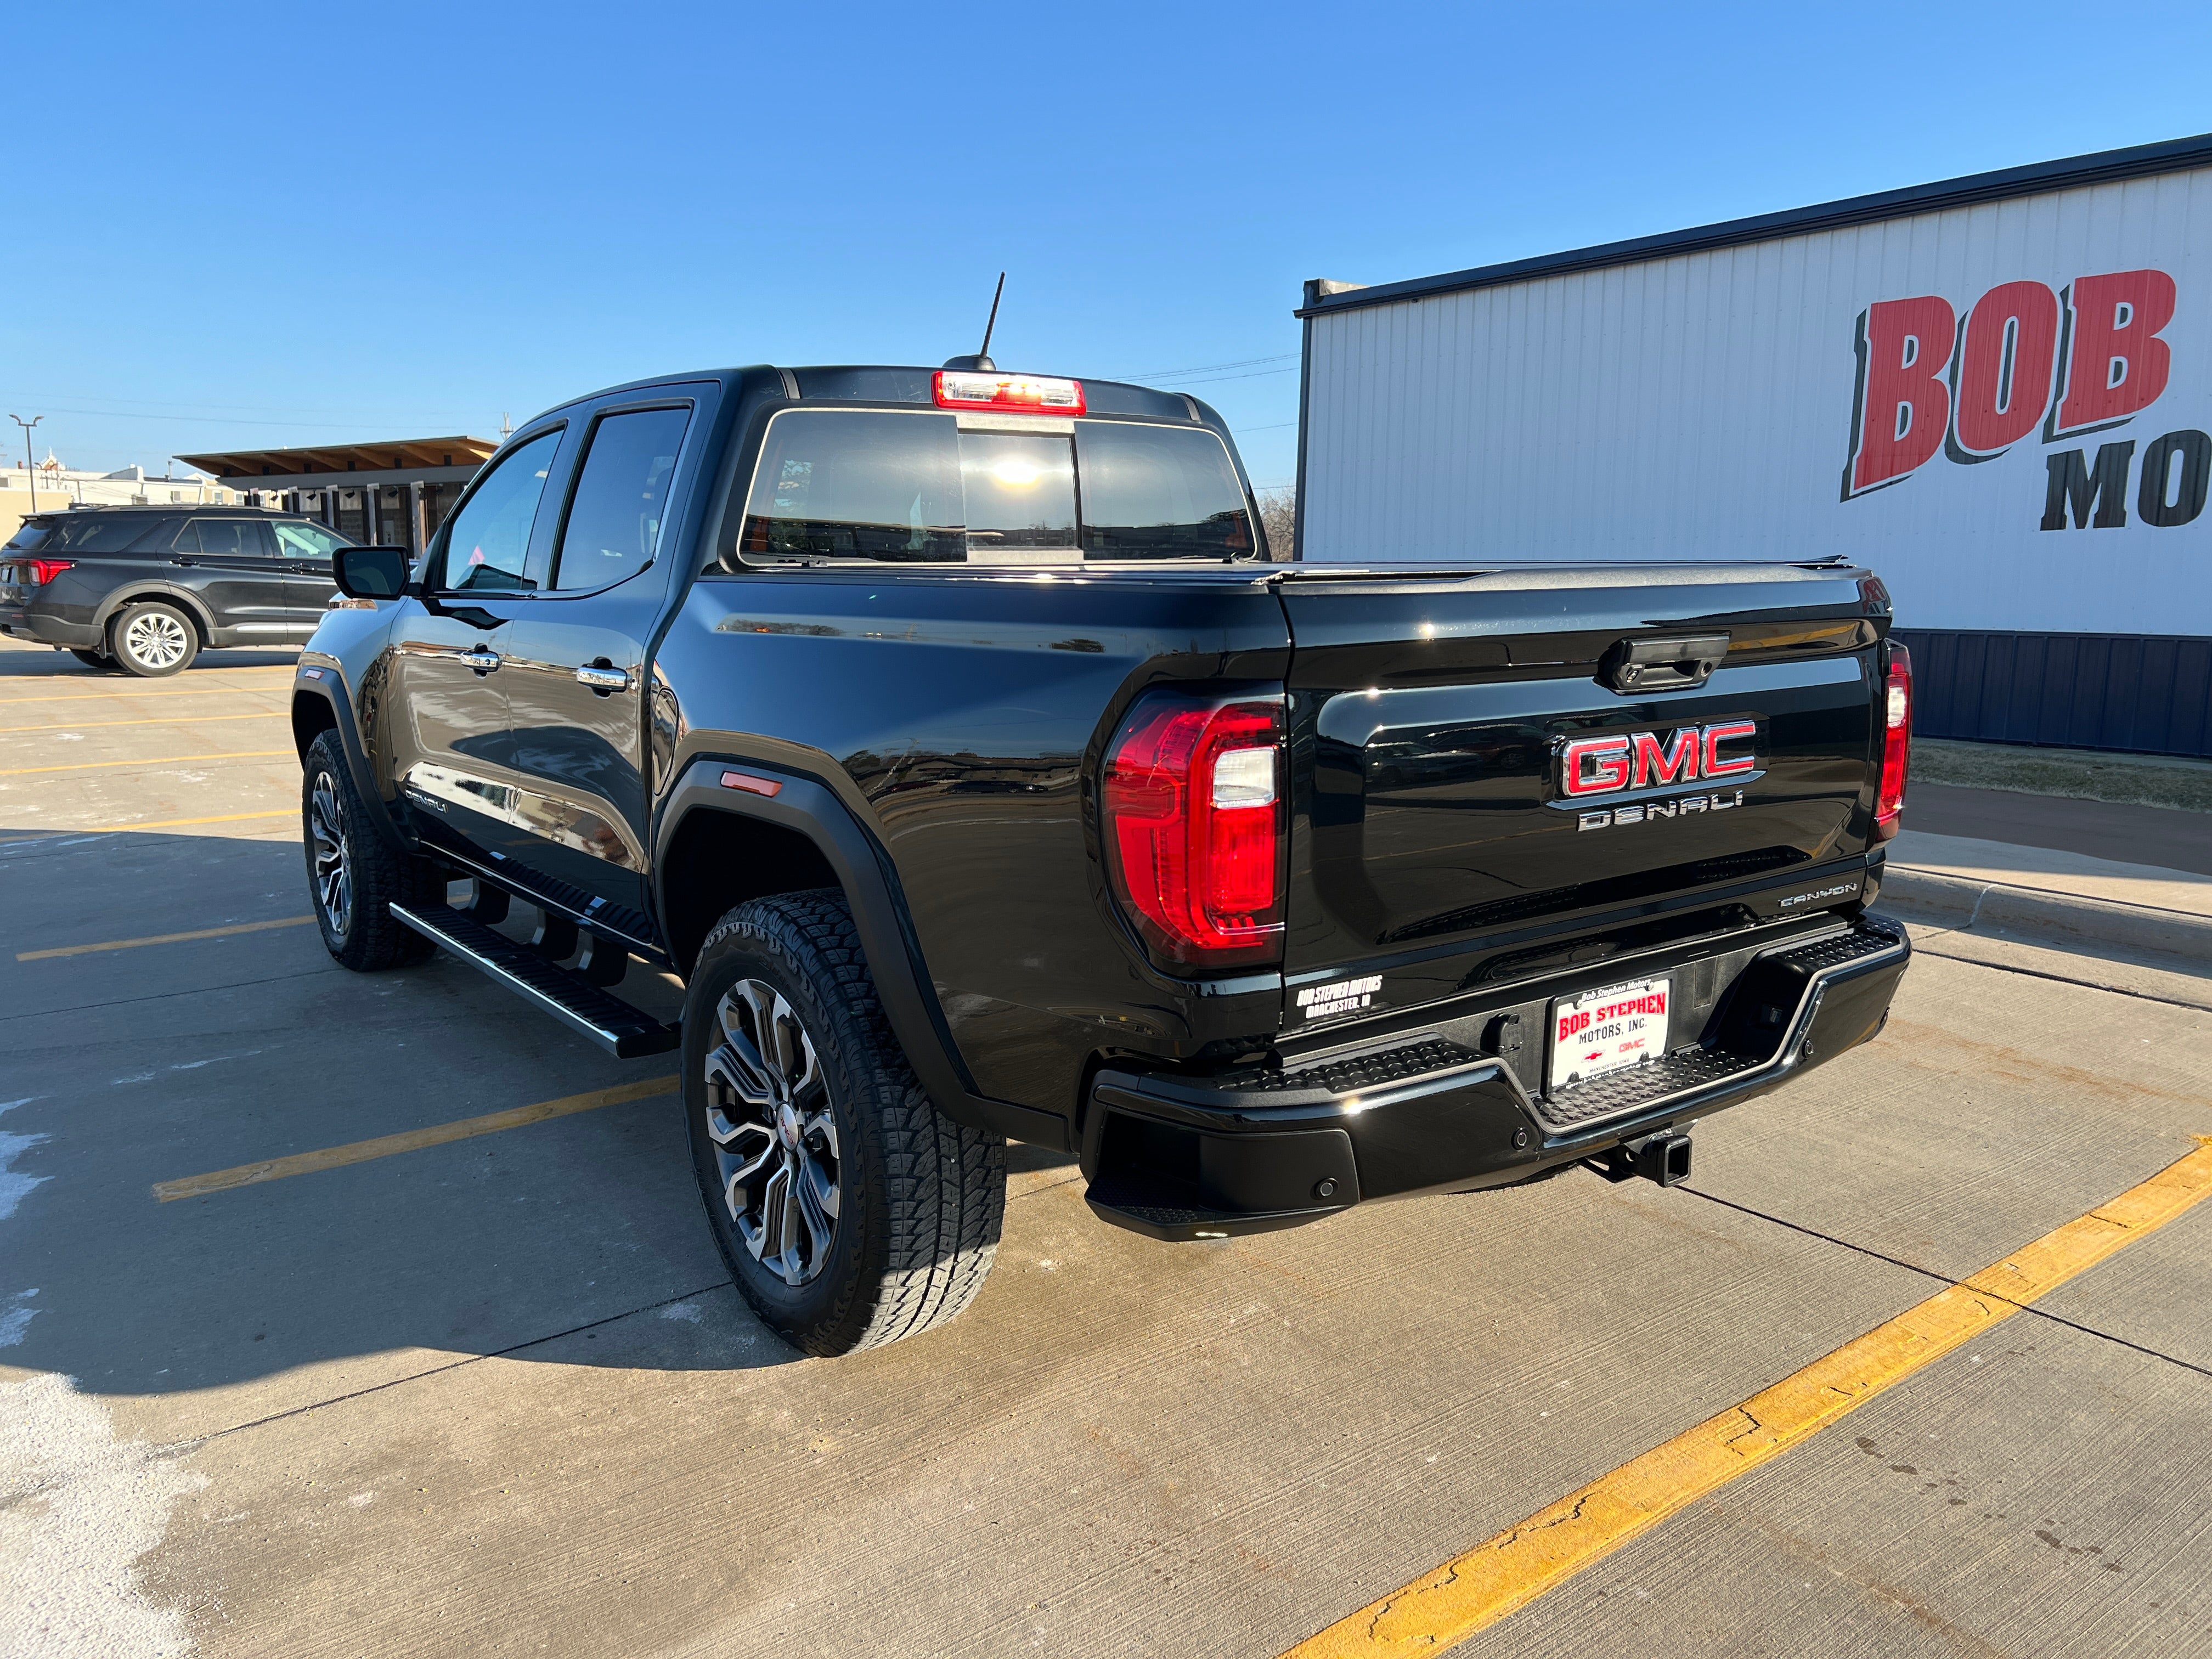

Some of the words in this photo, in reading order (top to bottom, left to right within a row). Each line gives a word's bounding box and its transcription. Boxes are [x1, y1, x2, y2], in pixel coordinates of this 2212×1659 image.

[1841, 269, 2176, 502] BOB
[2040, 430, 2212, 531] MO
[1561, 720, 1756, 797] GMC
[405, 789, 448, 814] DENALI
[1577, 789, 1743, 831] DENALI
[1778, 882, 1858, 907] CANYON
[1296, 989, 1316, 1007] BOB
[1314, 981, 1350, 1003] STEPHEN
[1348, 975, 1383, 996] MOTORS
[1361, 994, 1370, 1007] IA
[1581, 992, 1595, 1002] Bob
[1596, 985, 1626, 998] Stephen
[1627, 979, 1651, 992] Motors
[1558, 1011, 1590, 1043] BOB
[1596, 992, 1666, 1023] STEPHEN
[1579, 1023, 1624, 1044] MOTORS,
[1628, 1018, 1647, 1032] INC.
[1618, 1038, 1645, 1053] GMC
